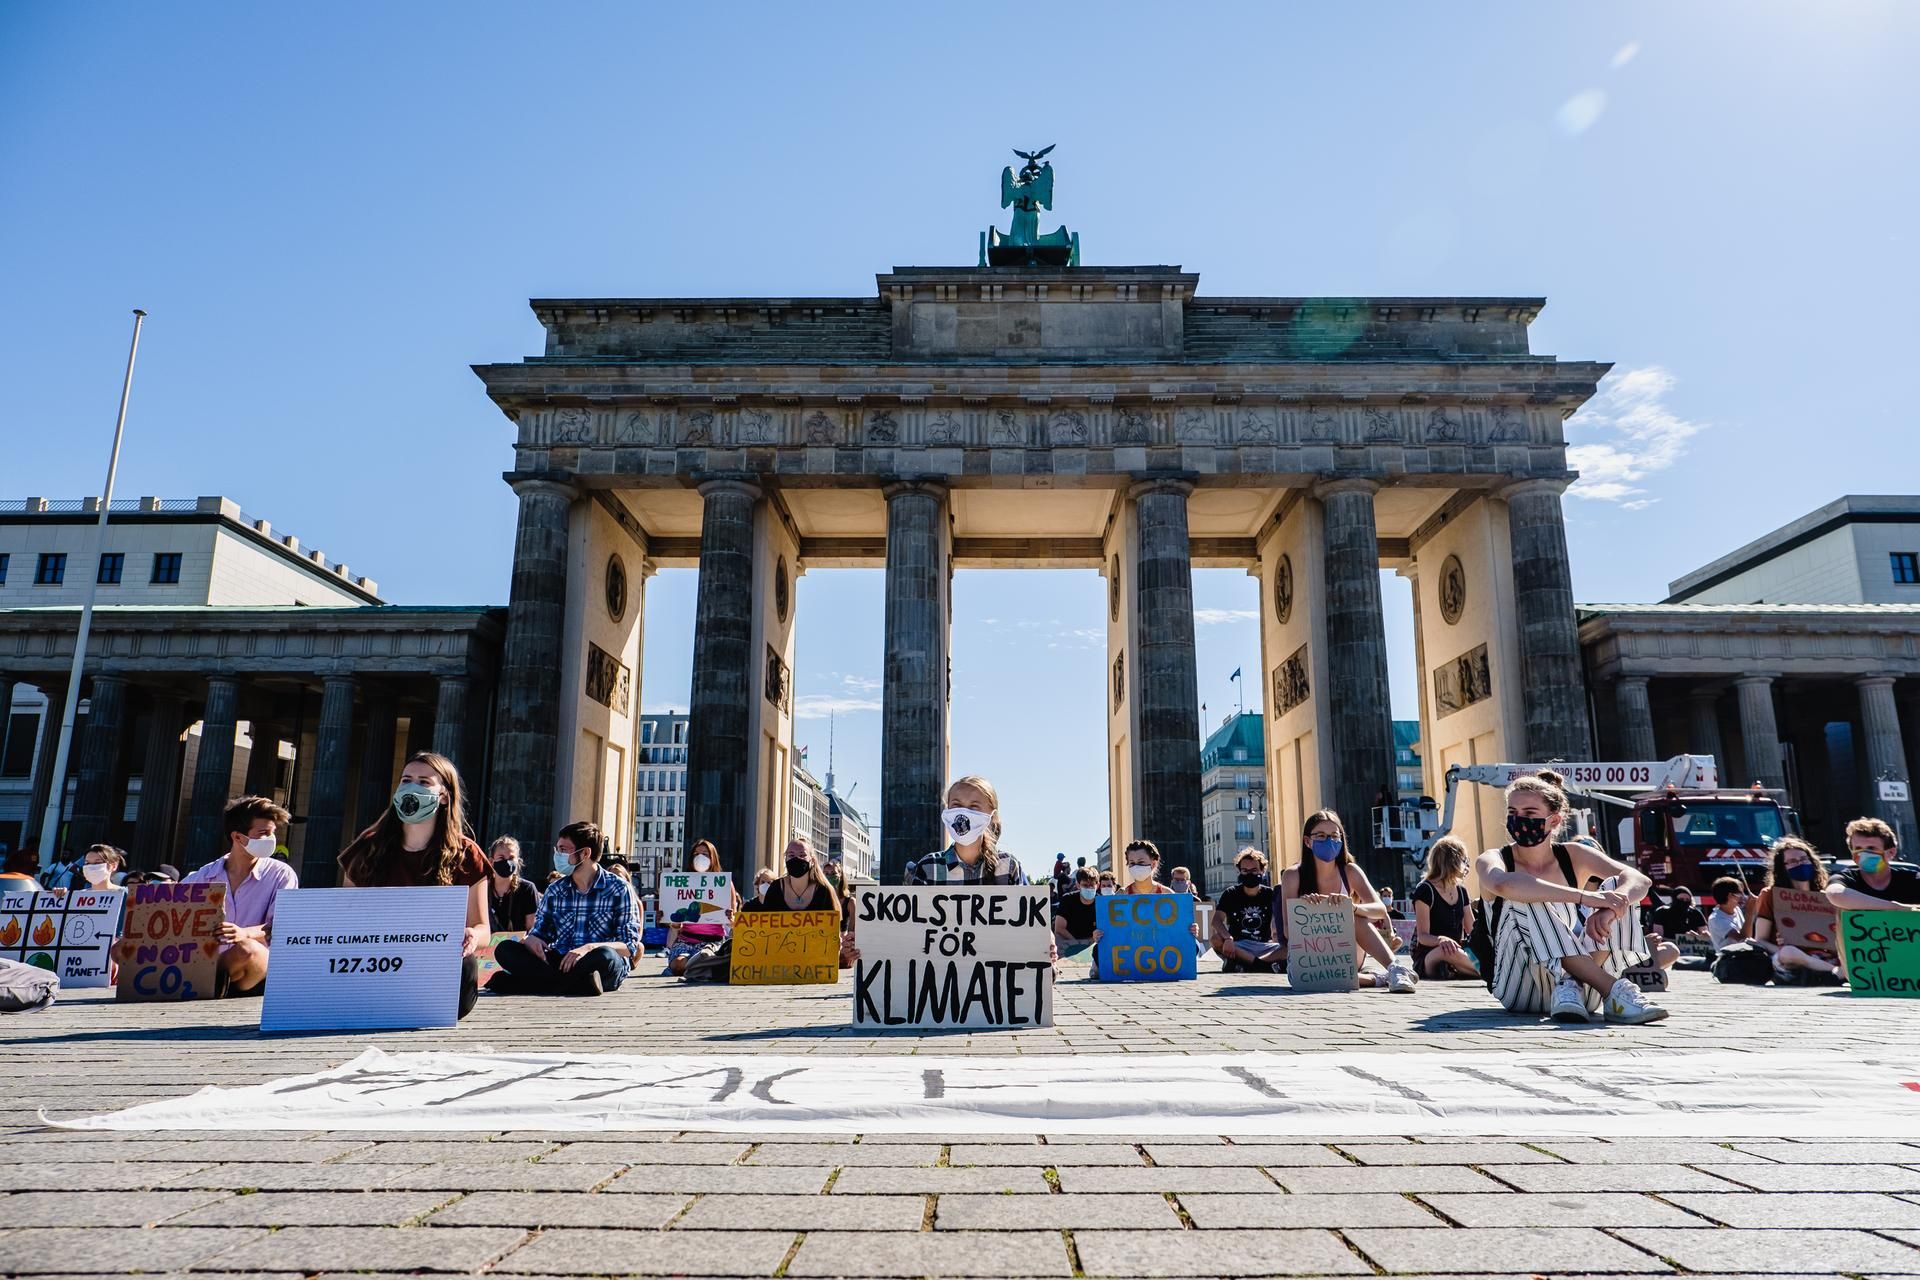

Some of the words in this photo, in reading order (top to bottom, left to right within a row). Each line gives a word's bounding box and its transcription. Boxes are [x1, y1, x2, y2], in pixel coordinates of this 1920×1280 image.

[1575, 767, 1601, 782] 530
[1606, 767, 1625, 782] 00
[1629, 767, 1650, 782] 03
[664, 875, 690, 888] THERE
[713, 875, 726, 888] NO
[6, 897, 25, 909] TIC
[40, 896, 65, 908] TAC
[135, 883, 210, 904] MAKE
[677, 888, 706, 901] PLANET
[708, 889, 714, 900] B
[1779, 890, 1823, 904] GLOBAL
[858, 891, 1049, 927] SKOLSTREJK
[1108, 897, 1178, 927] ECO
[125, 907, 218, 940] LOVE
[734, 911, 838, 928] APFELSAFT
[73, 920, 85, 939] B
[1300, 924, 1344, 936] CHANGE
[286, 935, 311, 945] FACE
[314, 935, 333, 945] THE
[336, 934, 380, 944] CLIMATE
[383, 933, 449, 943] EMERGENCY
[738, 929, 840, 956] STATT
[922, 926, 977, 957] FÖR
[1303, 936, 1337, 953] NOT
[66, 956, 82, 966] NO
[136, 943, 198, 965] NOT
[1111, 945, 1183, 975] EGO
[1298, 953, 1352, 969] CLIMATE
[1851, 940, 1892, 964] not
[65, 966, 101, 977] PLANET
[328, 956, 403, 974] 127.309
[1852, 965, 1920, 993] Silen
[855, 958, 1052, 1025] KLIMATET
